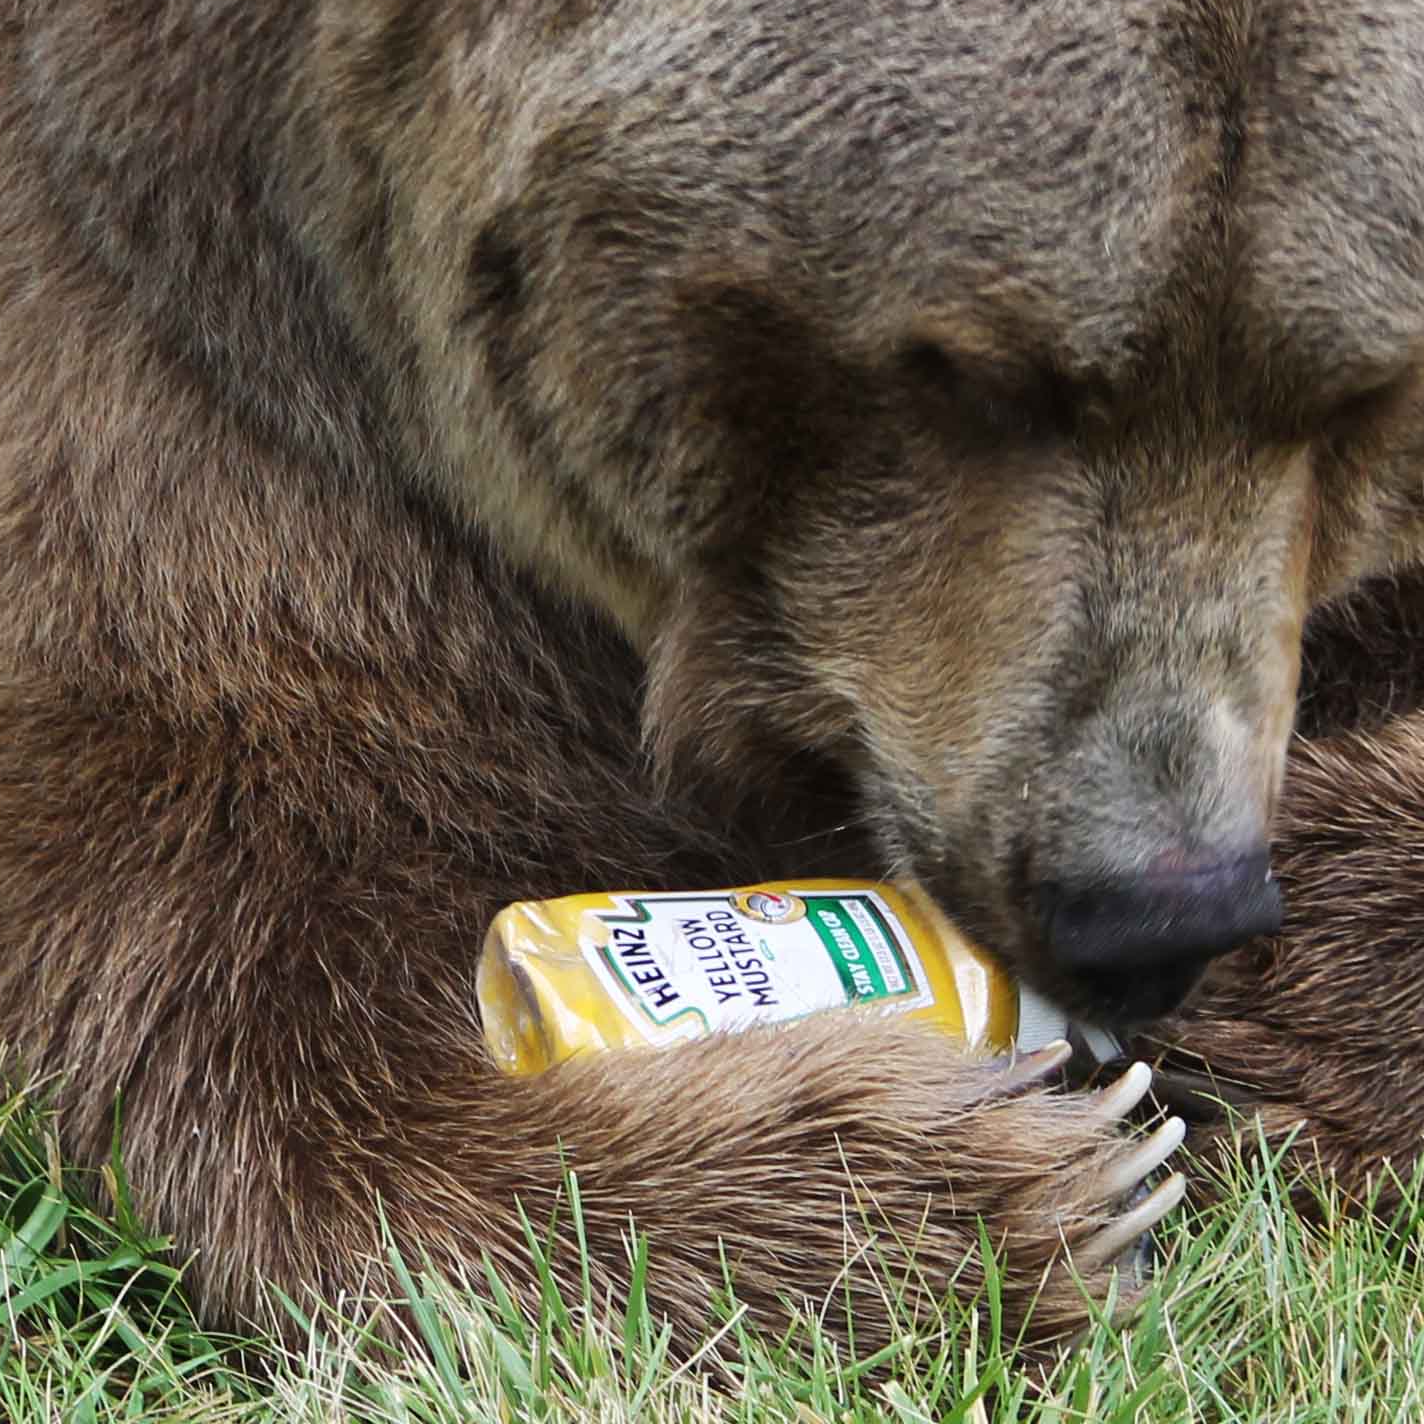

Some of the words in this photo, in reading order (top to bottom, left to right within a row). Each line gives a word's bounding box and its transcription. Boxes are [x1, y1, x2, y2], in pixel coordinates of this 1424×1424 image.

[613, 928, 680, 1007] HEINZ
[680, 919, 742, 1004] YELLOW
[706, 910, 779, 1006] MUSTARD
[830, 928, 860, 961] CLEAN
[847, 962, 874, 995] STAY
